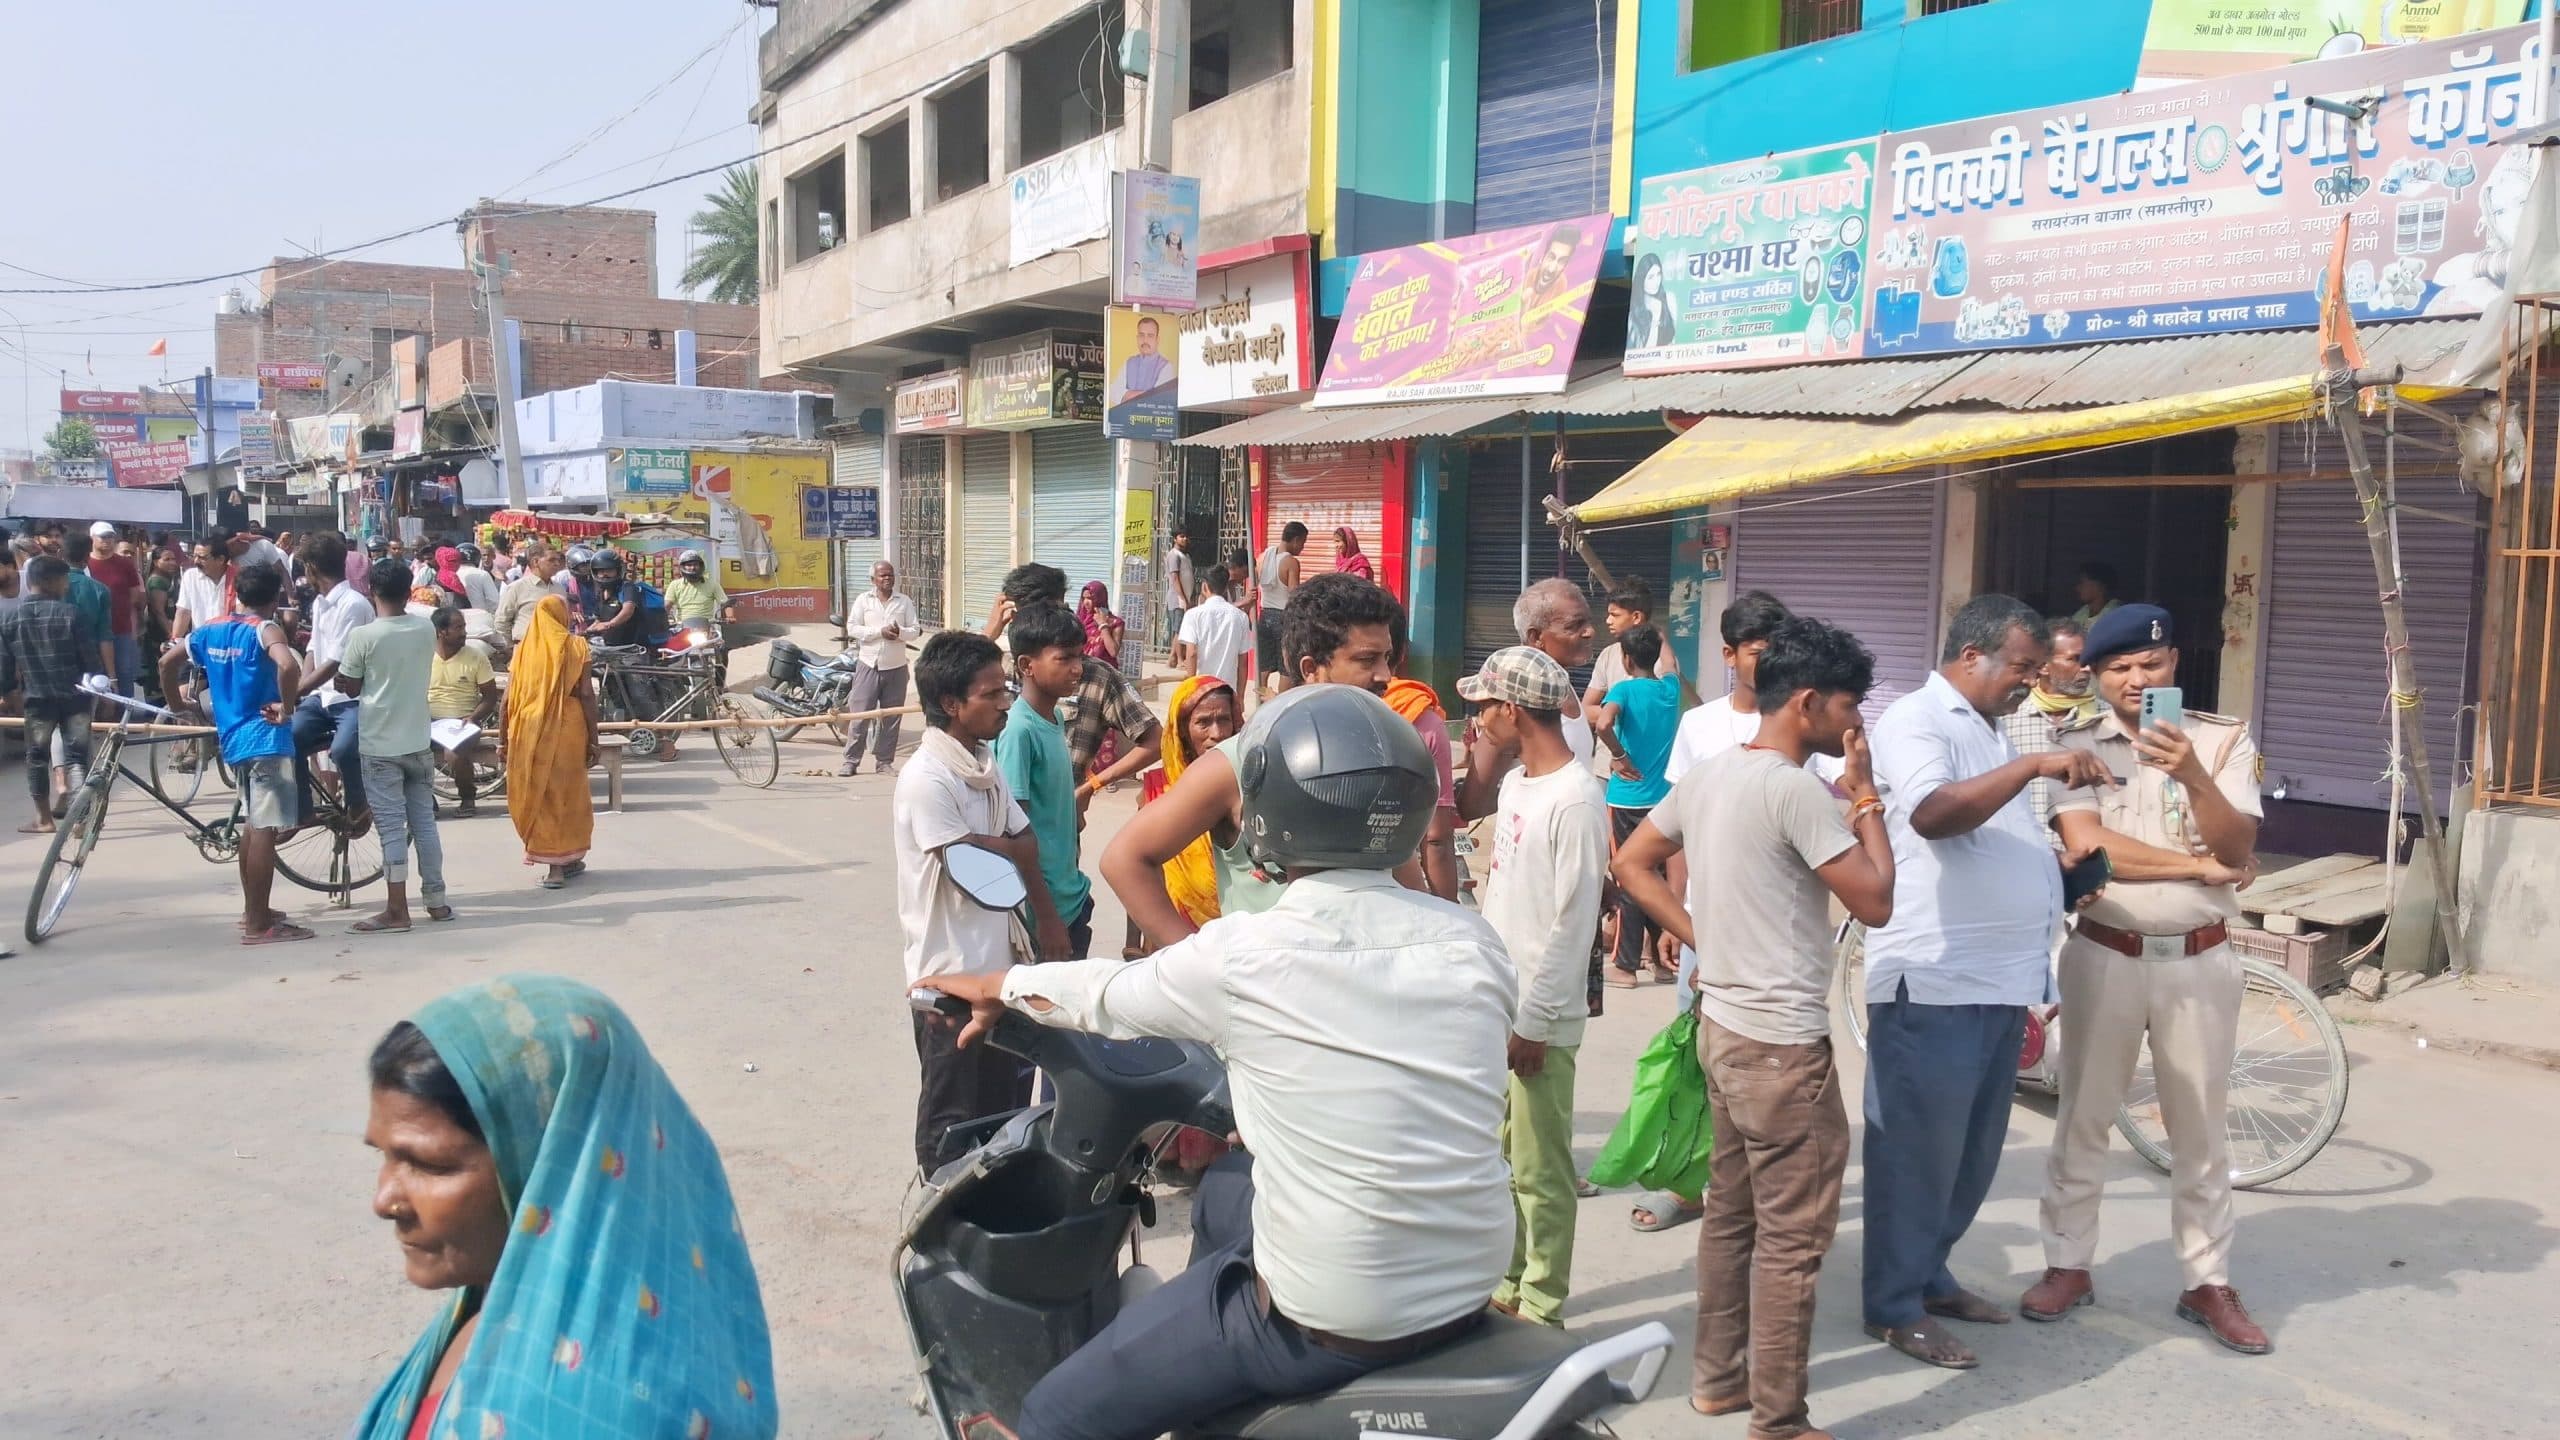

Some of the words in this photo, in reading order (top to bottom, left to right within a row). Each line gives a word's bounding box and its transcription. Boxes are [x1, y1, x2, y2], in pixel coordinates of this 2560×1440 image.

[2400, 3, 2442, 17] Anmol
[2194, 24, 2211, 37] 500
[2211, 24, 2224, 37] ml
[2256, 25, 2273, 38] 100
[2273, 26, 2287, 38] ml
[2133, 102, 2156, 118] जय
[2157, 96, 2191, 115] माता
[2194, 89, 2211, 109] दी
[1890, 125, 2033, 221] विक्की
[2043, 111, 2197, 200] बैंगल्स
[1028, 164, 1051, 197] SBI
[2031, 211, 2090, 231] सरायरंजन
[2094, 207, 2133, 224] बाजार
[2138, 196, 2214, 221] (समस्तीपुर)
[1688, 244, 1754, 280] चश्मा
[1761, 237, 1803, 274] घर
[1691, 285, 1718, 307] सेल
[1720, 282, 1750, 303] एण्ड
[1752, 275, 1793, 299] सर्विस
[2230, 274, 2247, 289] पर
[2126, 303, 2149, 329] श्री
[2152, 304, 2204, 326] महादेव
[2206, 303, 2252, 324] प्रसाद
[2255, 301, 2288, 319] साह
[1079, 340, 1105, 367] ज्वेल
[1626, 350, 1662, 362] SONATA
[1676, 347, 1704, 361] TITAN
[1386, 387, 1408, 399] RAJU
[1409, 386, 1426, 397] SAH
[1427, 384, 1458, 397] KIRANA
[1458, 382, 1486, 394] STORE
[837, 488, 871, 497] SBI
[753, 594, 815, 611] Engineering
[1375, 1411, 1428, 1431] PURE
